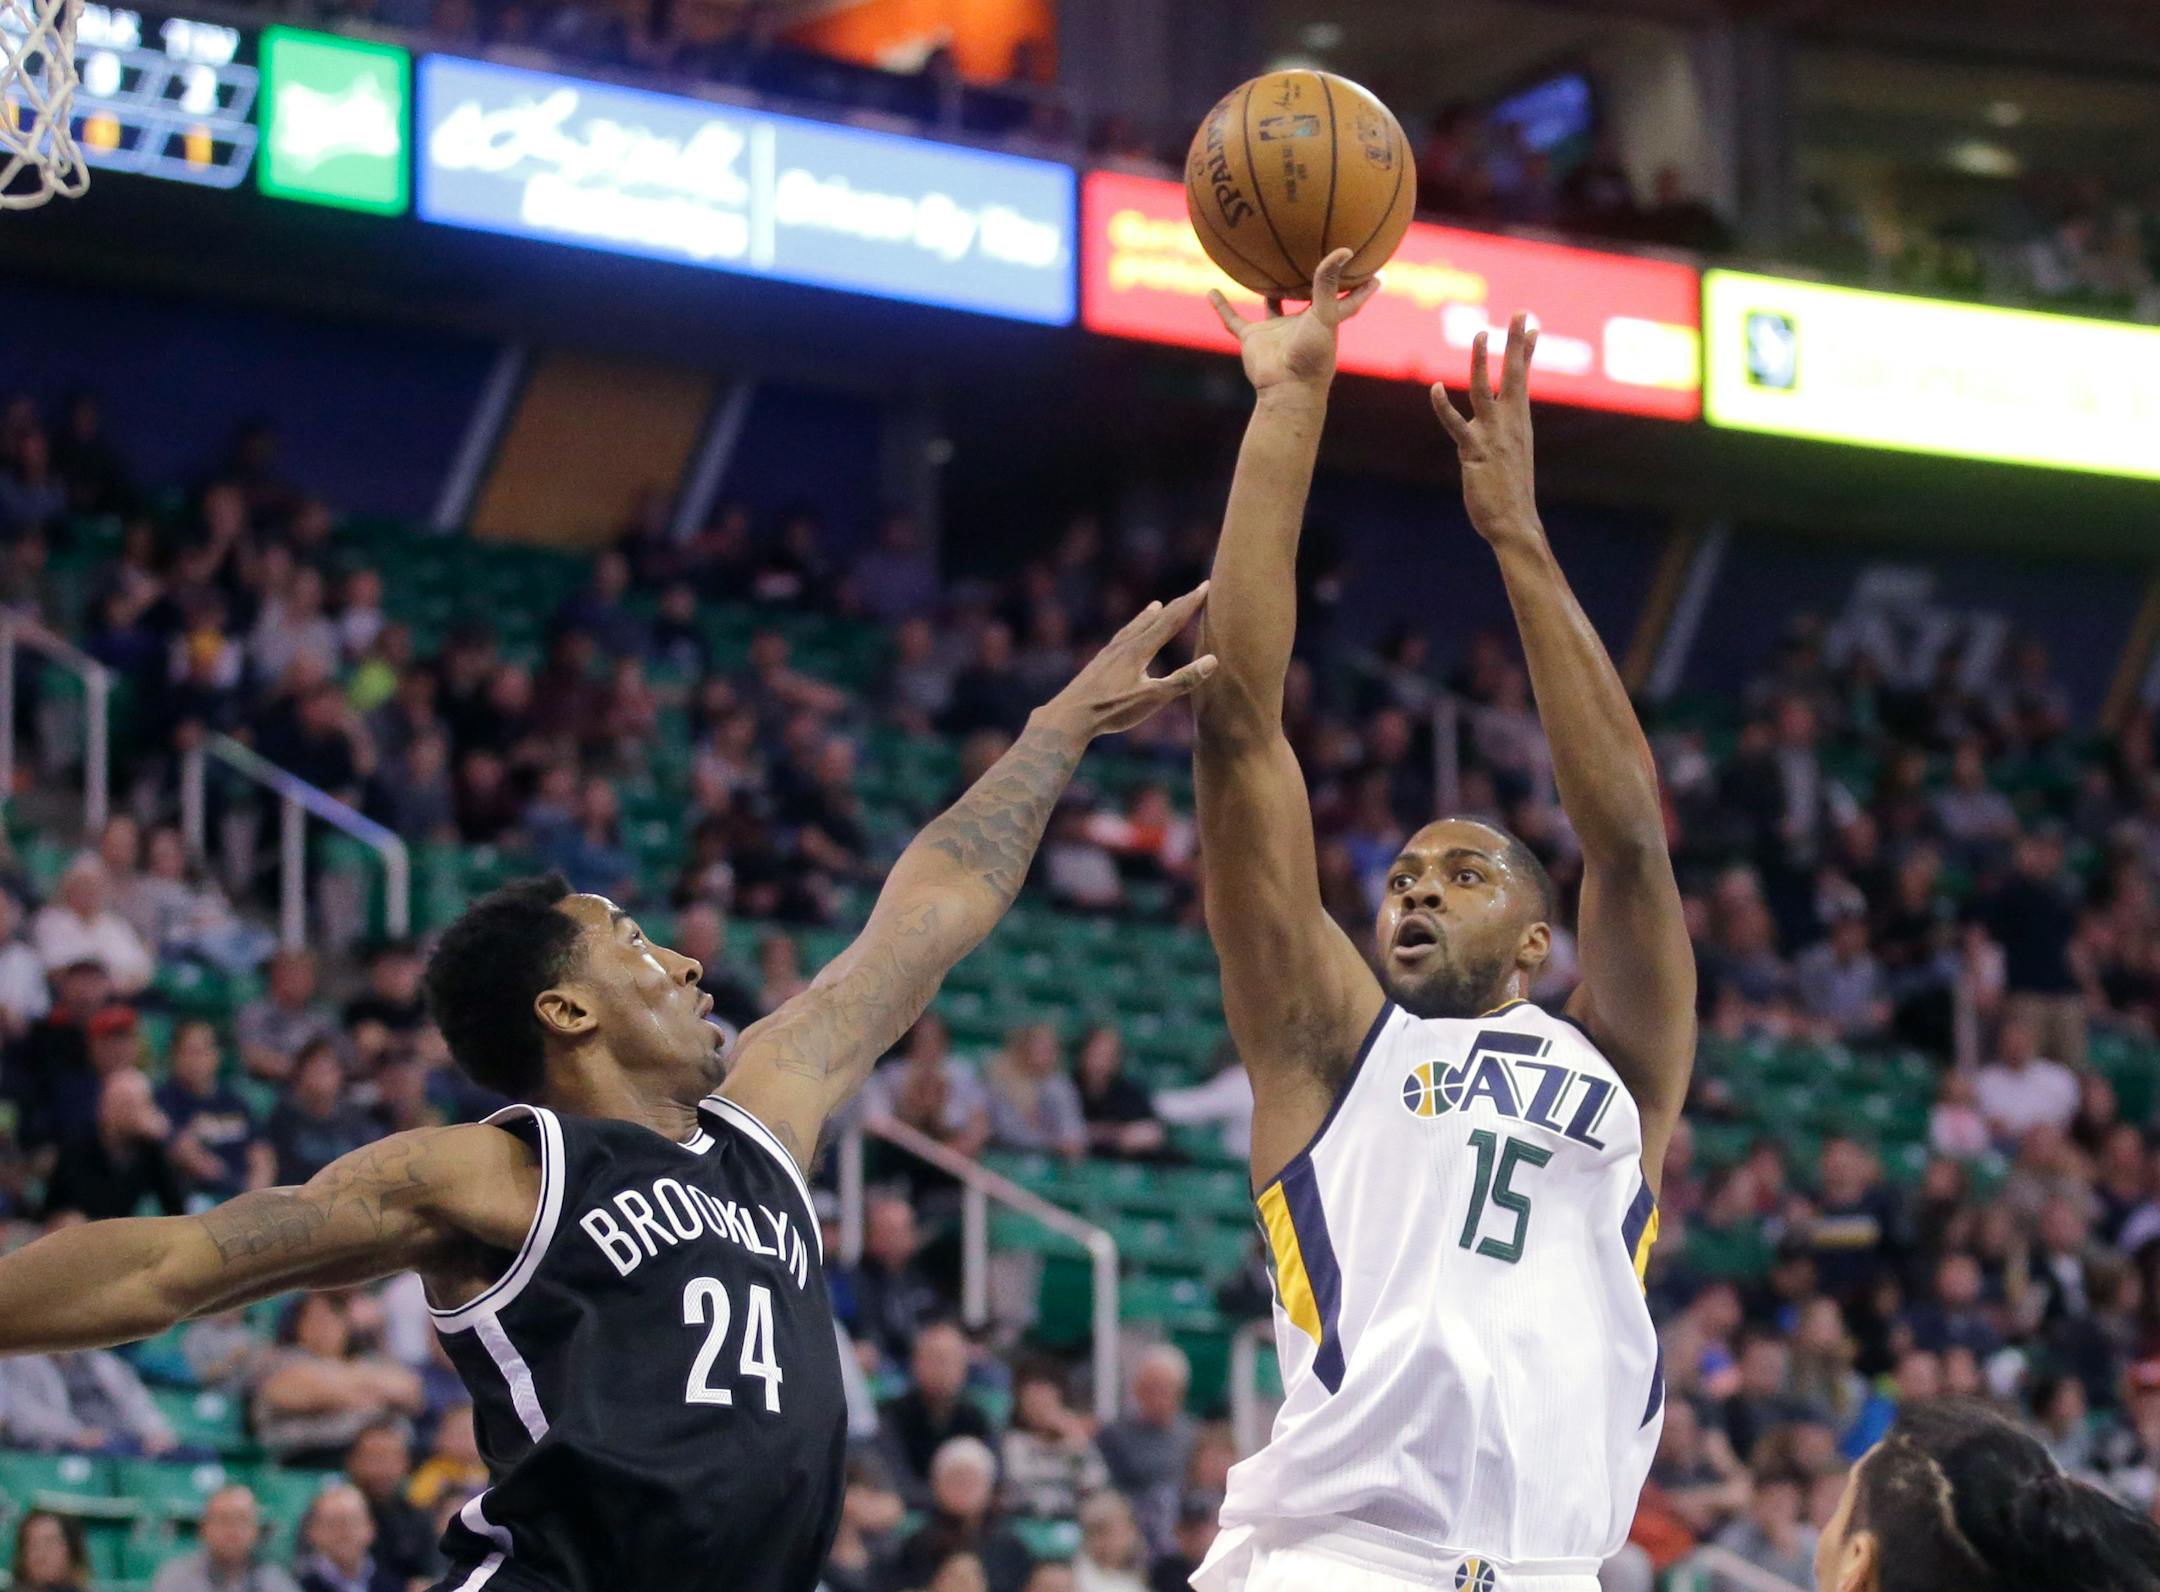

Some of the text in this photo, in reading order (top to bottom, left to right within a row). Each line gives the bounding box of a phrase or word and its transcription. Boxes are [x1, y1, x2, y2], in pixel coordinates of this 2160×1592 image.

[1402, 1029, 1619, 1152] JAZZ
[579, 1178, 808, 1290] BROOKLYN
[1458, 1128, 1554, 1264] 15
[683, 1276, 783, 1413] 24
